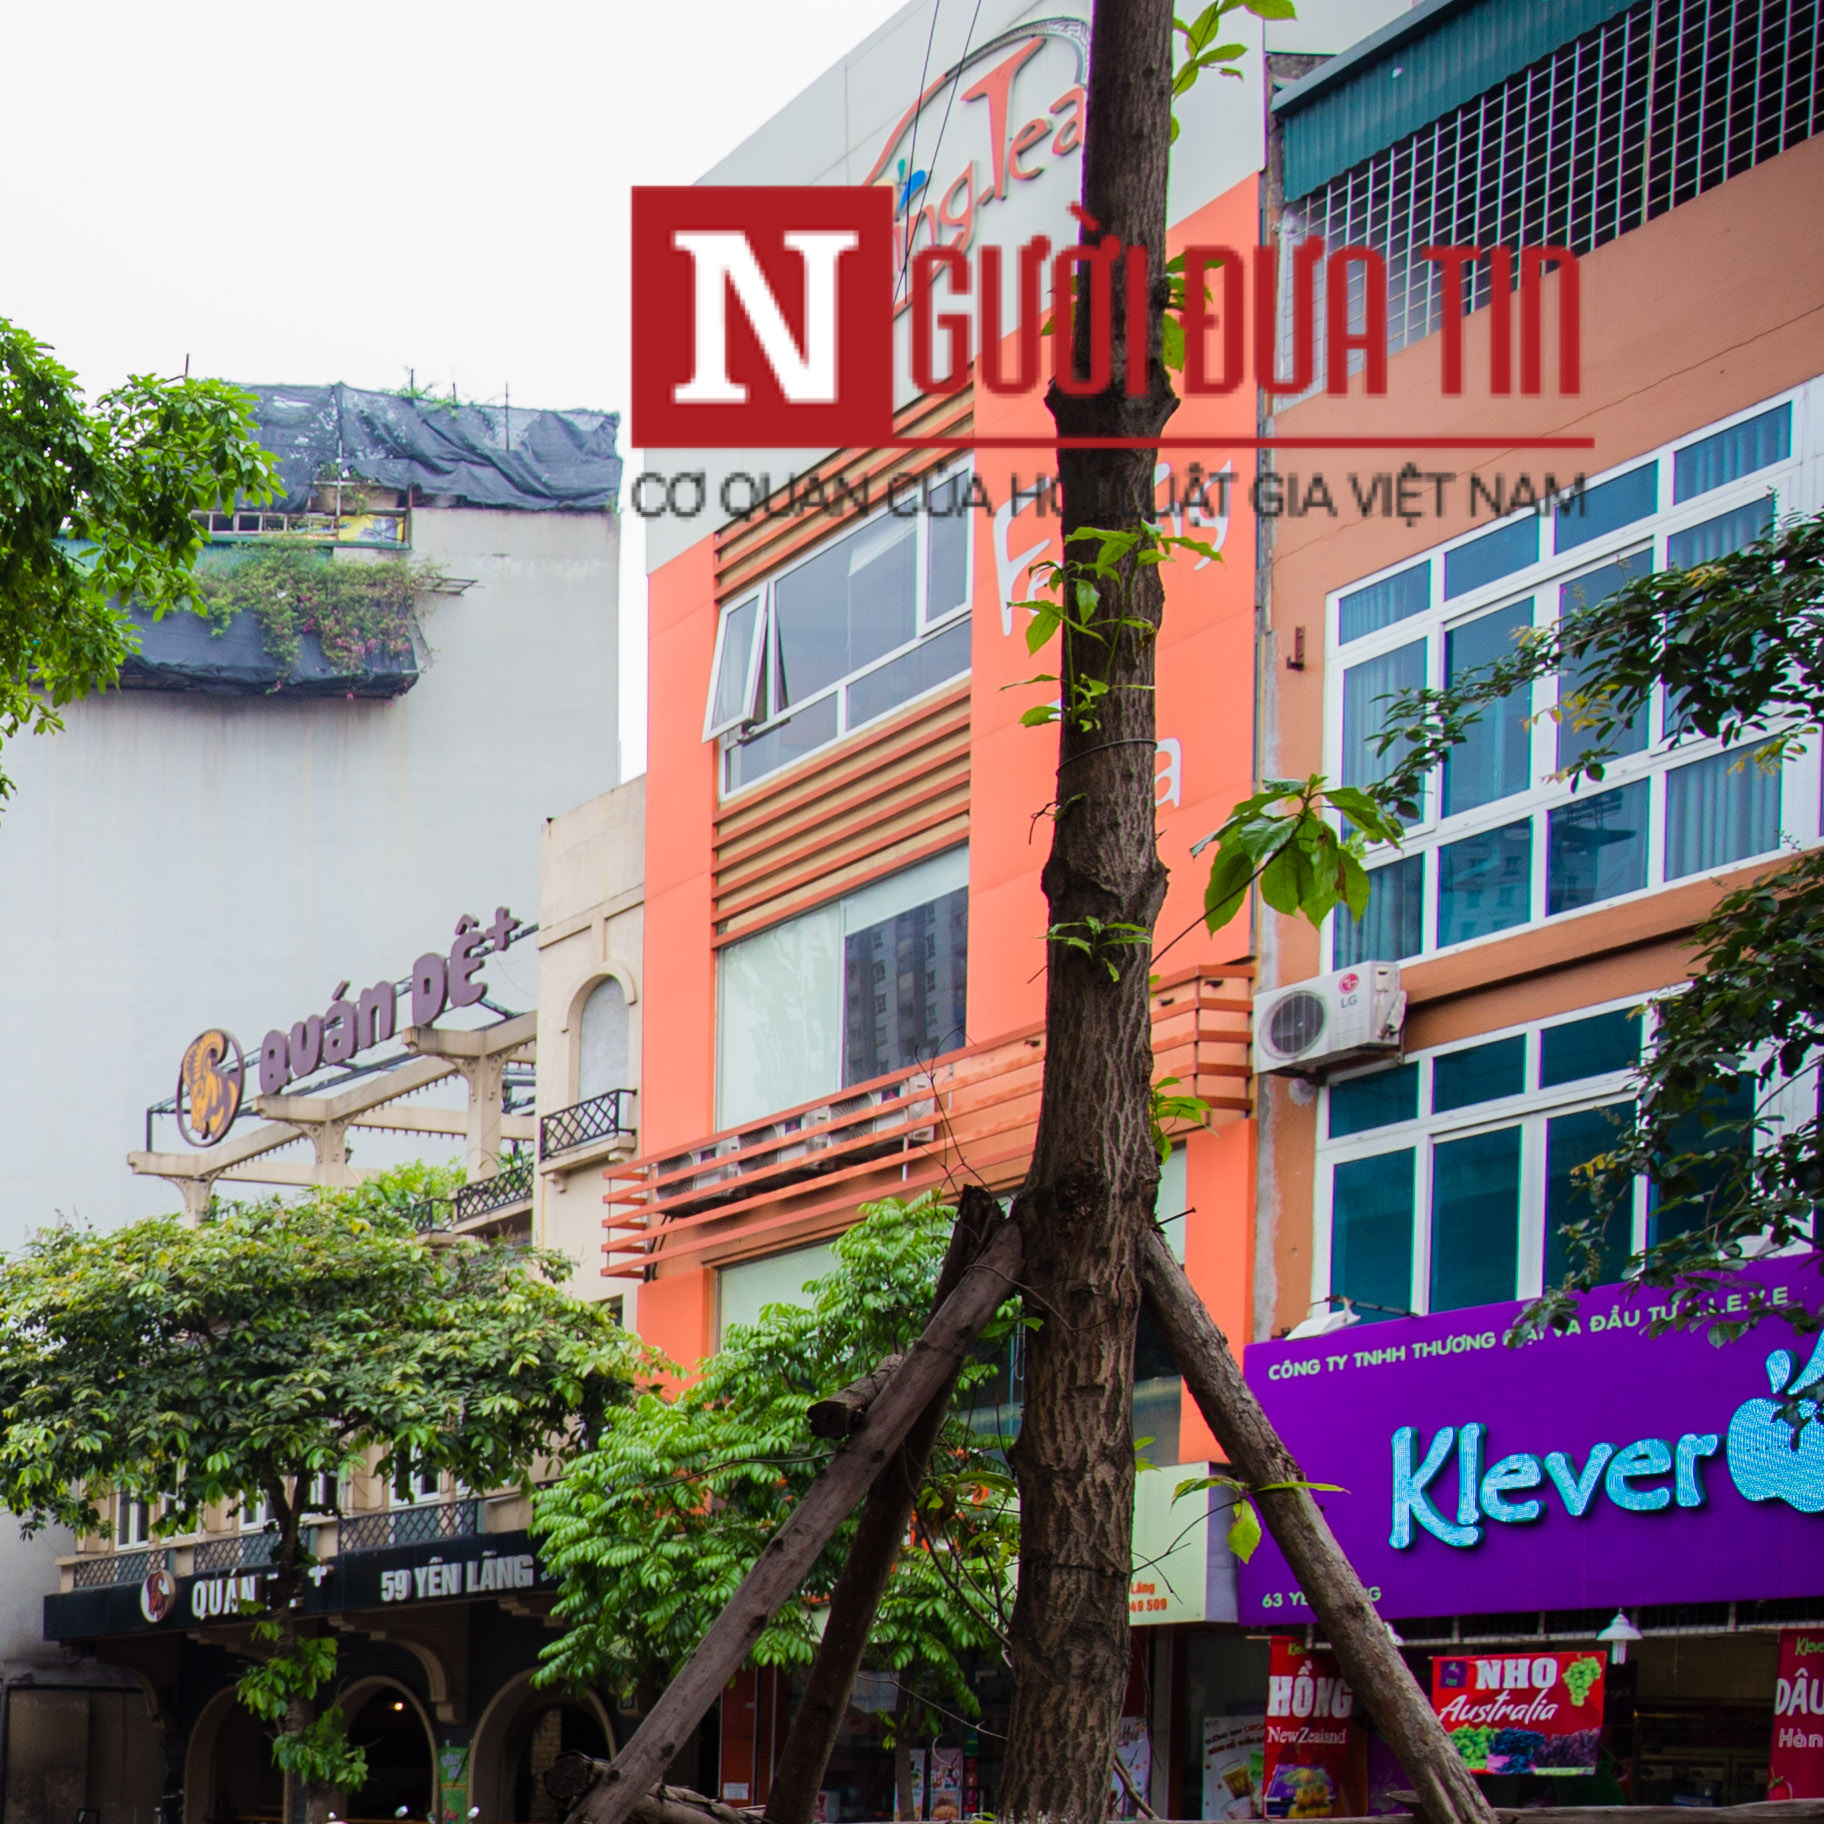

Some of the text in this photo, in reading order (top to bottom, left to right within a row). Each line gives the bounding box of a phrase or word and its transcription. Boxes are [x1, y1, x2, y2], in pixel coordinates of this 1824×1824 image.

[1341, 994, 1358, 1009] LG
[1267, 1356, 1321, 1381] CÔNG
[1325, 1353, 1349, 1373] TY
[1353, 1347, 1407, 1369] TNHH
[1411, 1331, 1497, 1360] THƯƠNG
[1588, 1304, 1641, 1333] ĐẦU
[1388, 1421, 1722, 1550] Klever
[381, 1568, 413, 1602] 59
[414, 1556, 463, 1599] YÊN
[465, 1549, 535, 1593] LÃNG
[1261, 1591, 1283, 1608] 63
[1266, 1660, 1353, 1719] HỒNG
[1474, 1657, 1558, 1690] NHO
[1438, 1687, 1559, 1725] Australia
